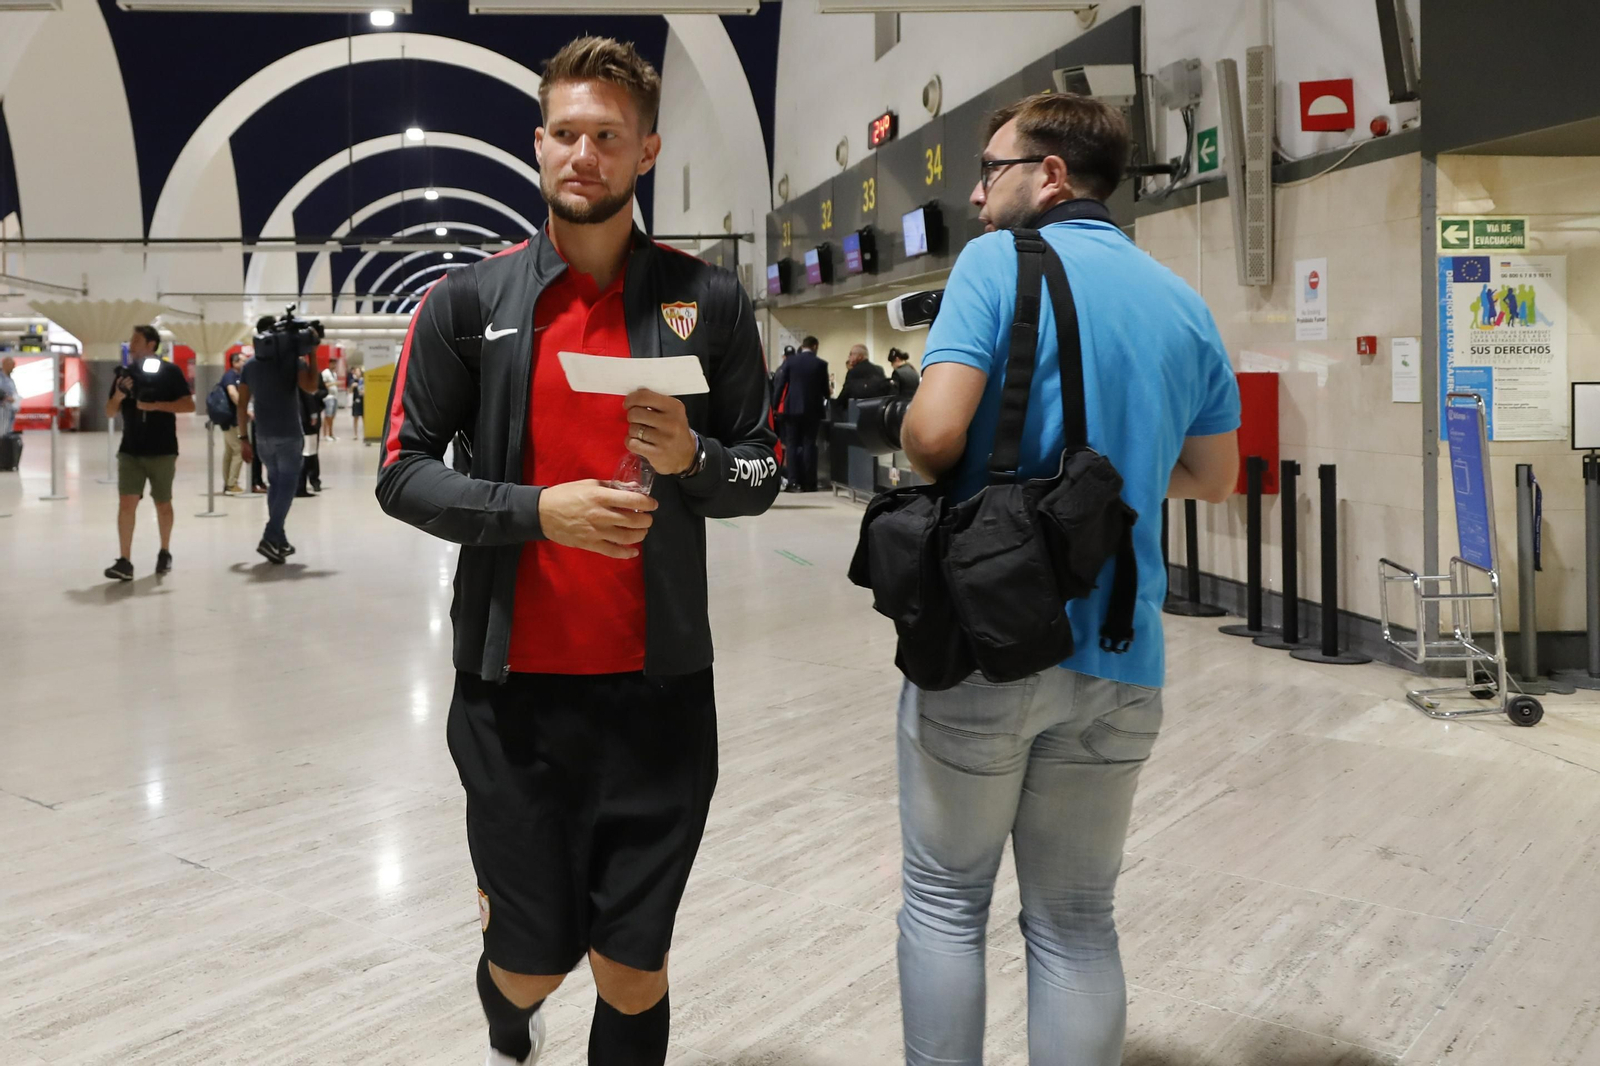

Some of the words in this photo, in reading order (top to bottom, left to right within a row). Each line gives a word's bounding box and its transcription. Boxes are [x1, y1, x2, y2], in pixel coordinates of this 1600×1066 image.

[925, 144, 943, 185] 34
[862, 177, 875, 213] 33
[821, 200, 832, 230] 32
[1501, 224, 1511, 233] DE
[782, 221, 791, 248] 31
[1446, 270, 1454, 317] DERECHOS
[1446, 318, 1454, 331] DE
[1470, 346, 1490, 354] SUS
[1494, 346, 1551, 354] DERECHOS
